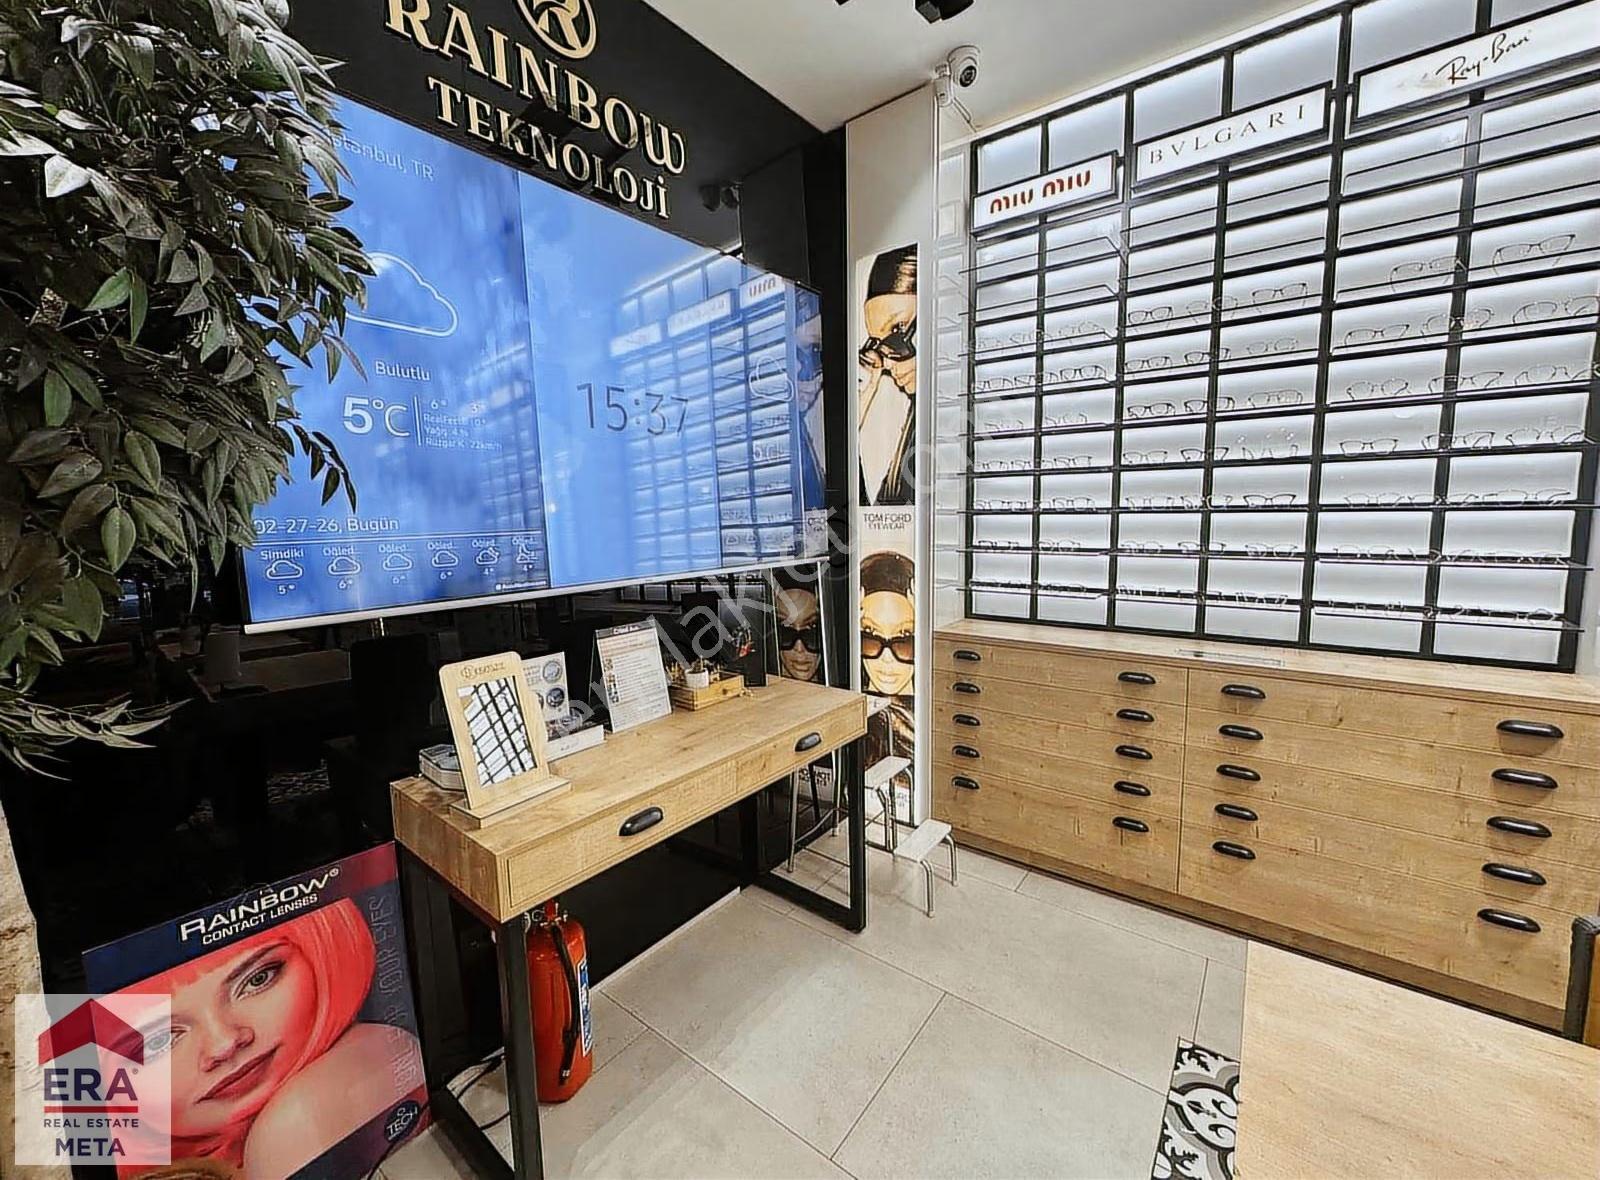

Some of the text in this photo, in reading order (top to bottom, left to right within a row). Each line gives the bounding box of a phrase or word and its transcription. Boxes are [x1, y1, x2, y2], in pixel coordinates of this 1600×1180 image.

[1434, 31, 1531, 85] Ray-Ban
[385, 0, 686, 175] RAINBOW
[331, 131, 435, 181] stanbul, TR
[1149, 104, 1304, 164] BVLGARI
[374, 360, 431, 381] Bulutlu
[576, 383, 688, 436] 15:37
[347, 517, 399, 534] Bugün
[202, 893, 318, 945] CONTACT LENSES
